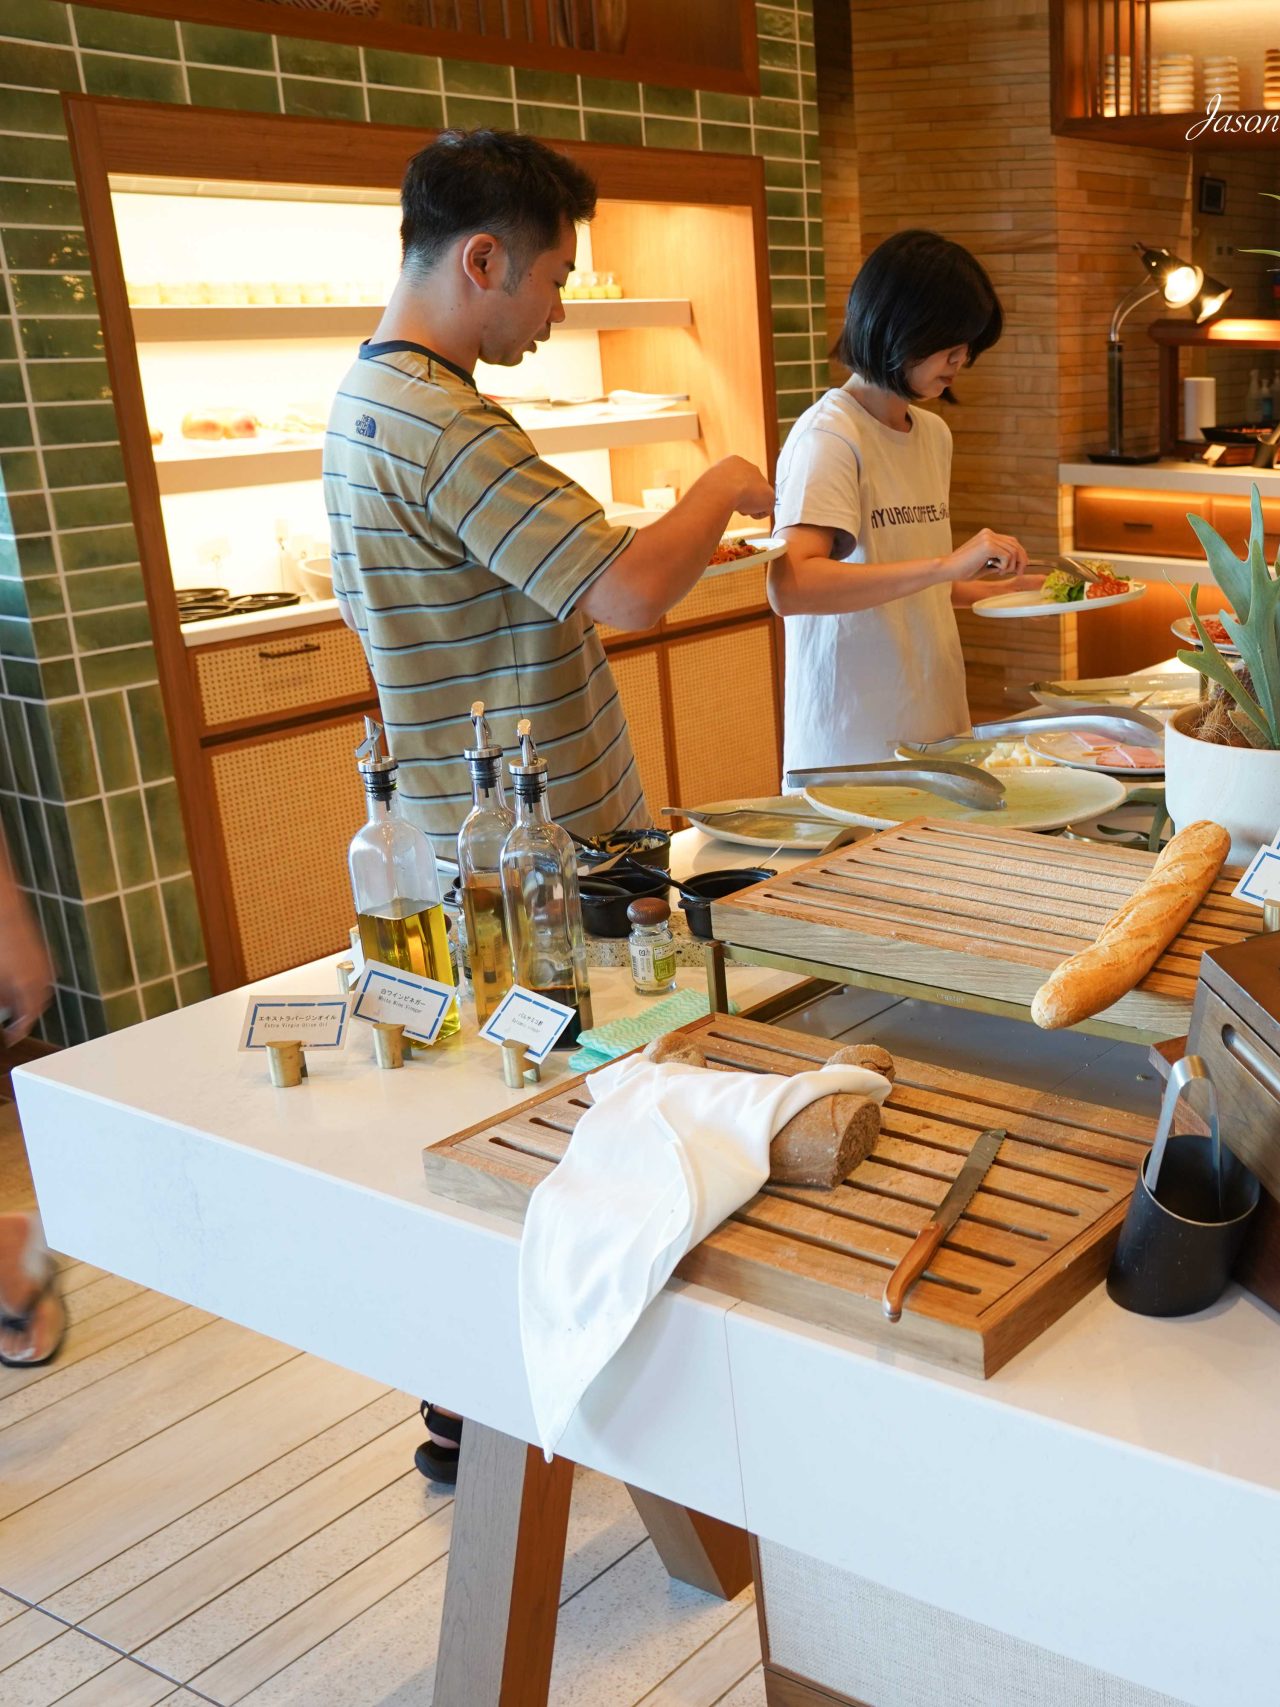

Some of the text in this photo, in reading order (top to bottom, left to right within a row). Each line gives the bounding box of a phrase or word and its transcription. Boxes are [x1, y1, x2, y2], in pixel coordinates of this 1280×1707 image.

[380, 988, 426, 1007] 白ワインビネガー
